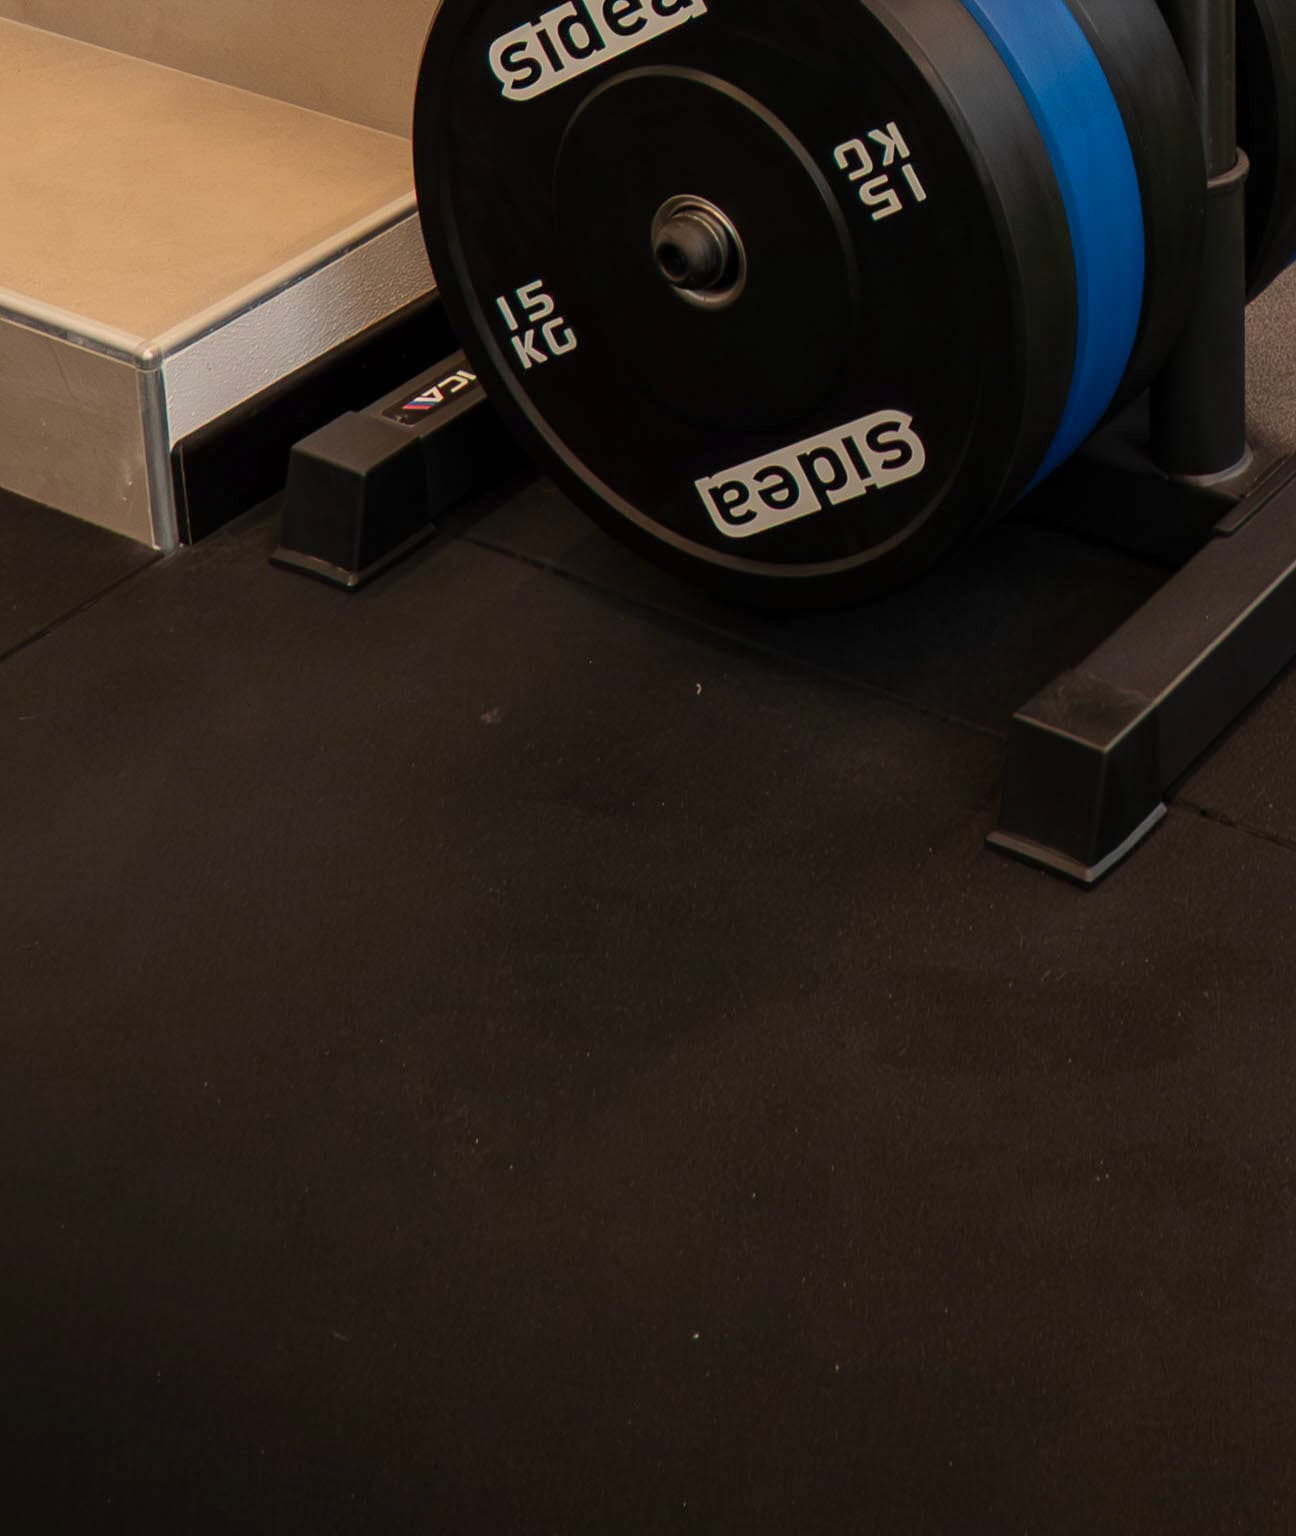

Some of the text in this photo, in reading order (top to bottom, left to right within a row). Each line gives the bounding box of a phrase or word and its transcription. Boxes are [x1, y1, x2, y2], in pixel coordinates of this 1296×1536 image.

[833, 120, 912, 183] KG
[857, 162, 929, 222] 15
[495, 278, 558, 334] 15
[510, 314, 579, 371] KG
[695, 409, 926, 539] sidea
